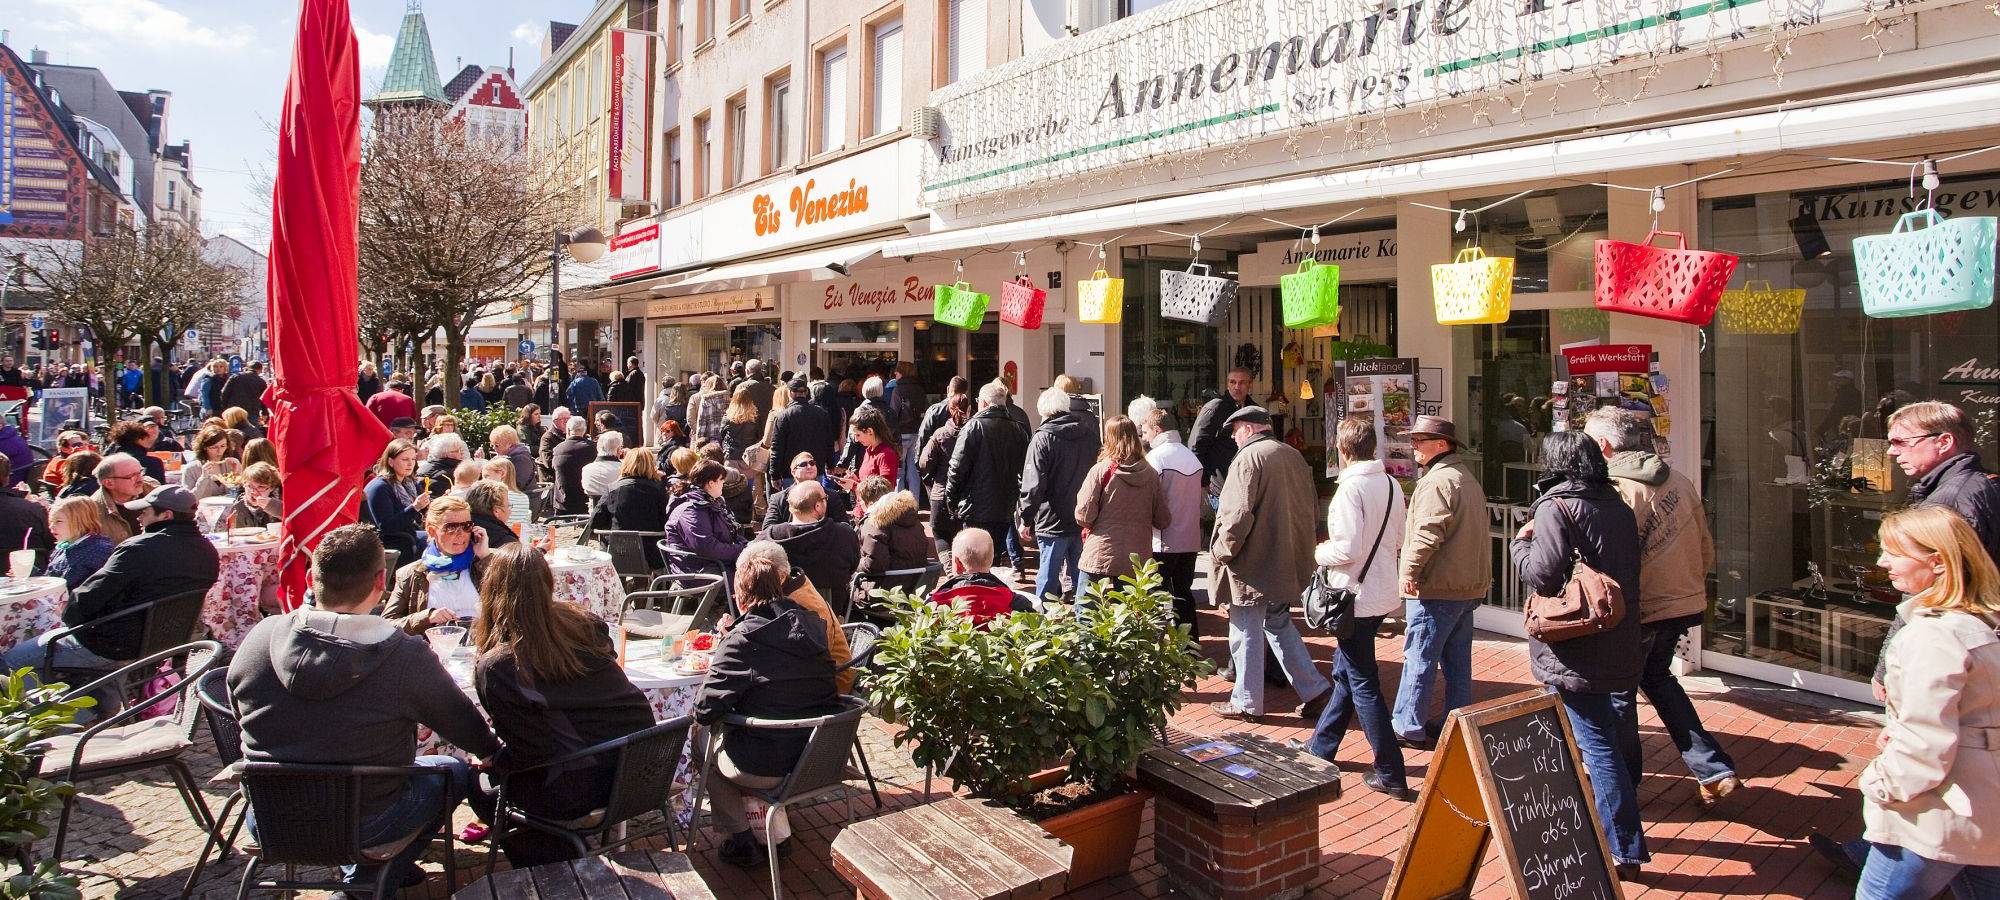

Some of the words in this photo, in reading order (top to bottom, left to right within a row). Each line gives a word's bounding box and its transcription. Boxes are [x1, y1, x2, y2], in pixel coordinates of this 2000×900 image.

[1091, 0, 1471, 125] Annemarie
[1291, 86, 1337, 114] Seit
[1349, 66, 1412, 102] 1955
[939, 114, 1070, 166] Kunstgewerbe
[753, 193, 781, 236] Eis
[790, 178, 869, 228] Venezia
[823, 284, 844, 310] Eis
[849, 282, 898, 312] Venezia
[1047, 271, 1062, 289] 12
[1570, 353, 1596, 365] Grafik
[1598, 352, 1646, 362] Werkstatt
[1513, 734, 1532, 750] uns
